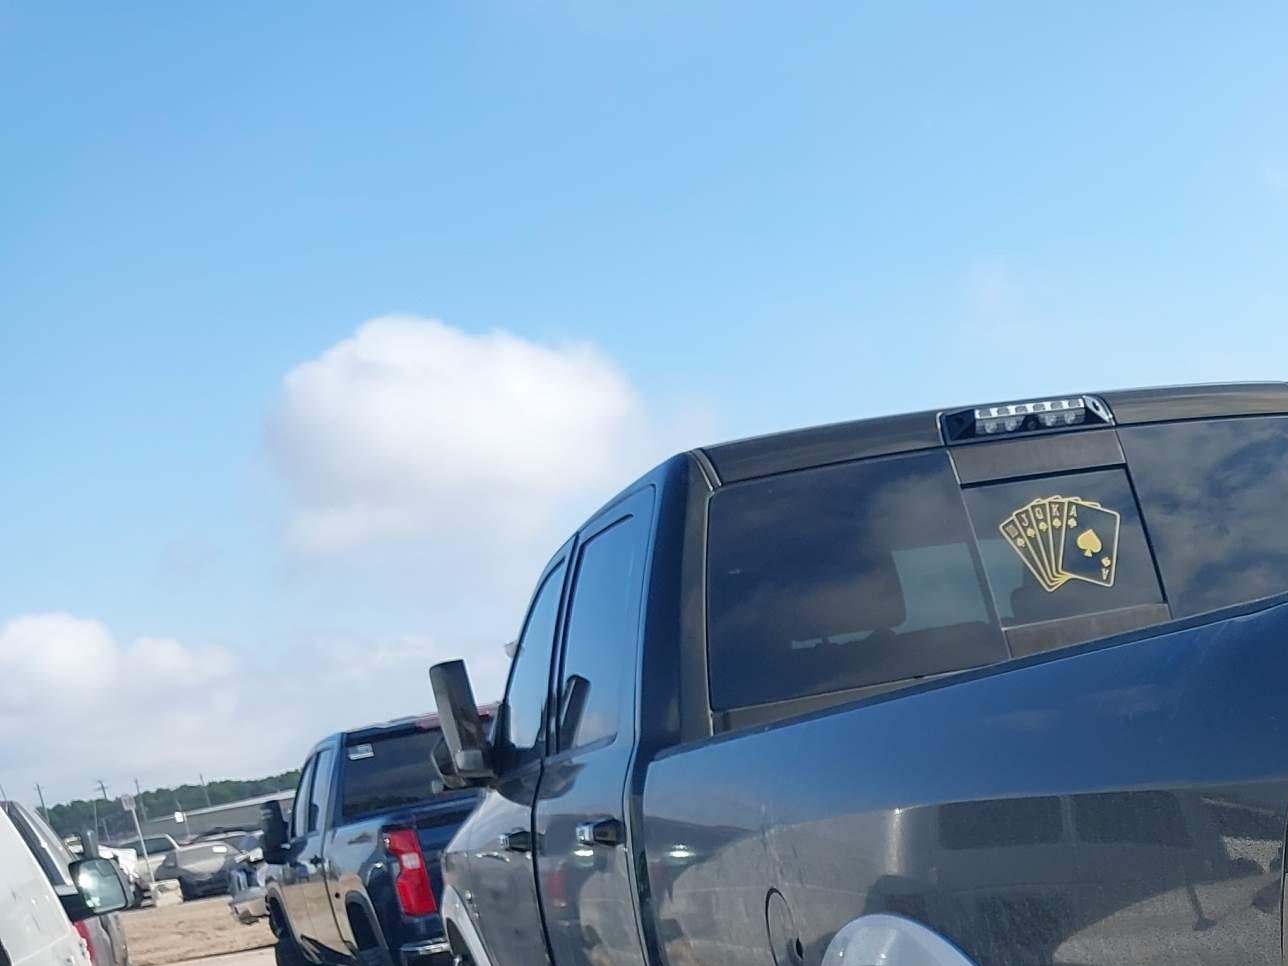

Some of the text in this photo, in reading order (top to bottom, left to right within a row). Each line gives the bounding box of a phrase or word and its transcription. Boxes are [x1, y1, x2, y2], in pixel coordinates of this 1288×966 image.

[1020, 514, 1030, 527] J
[1051, 504, 1061, 517] K
[1069, 505, 1078, 517] A
[1101, 568, 1110, 581] A
